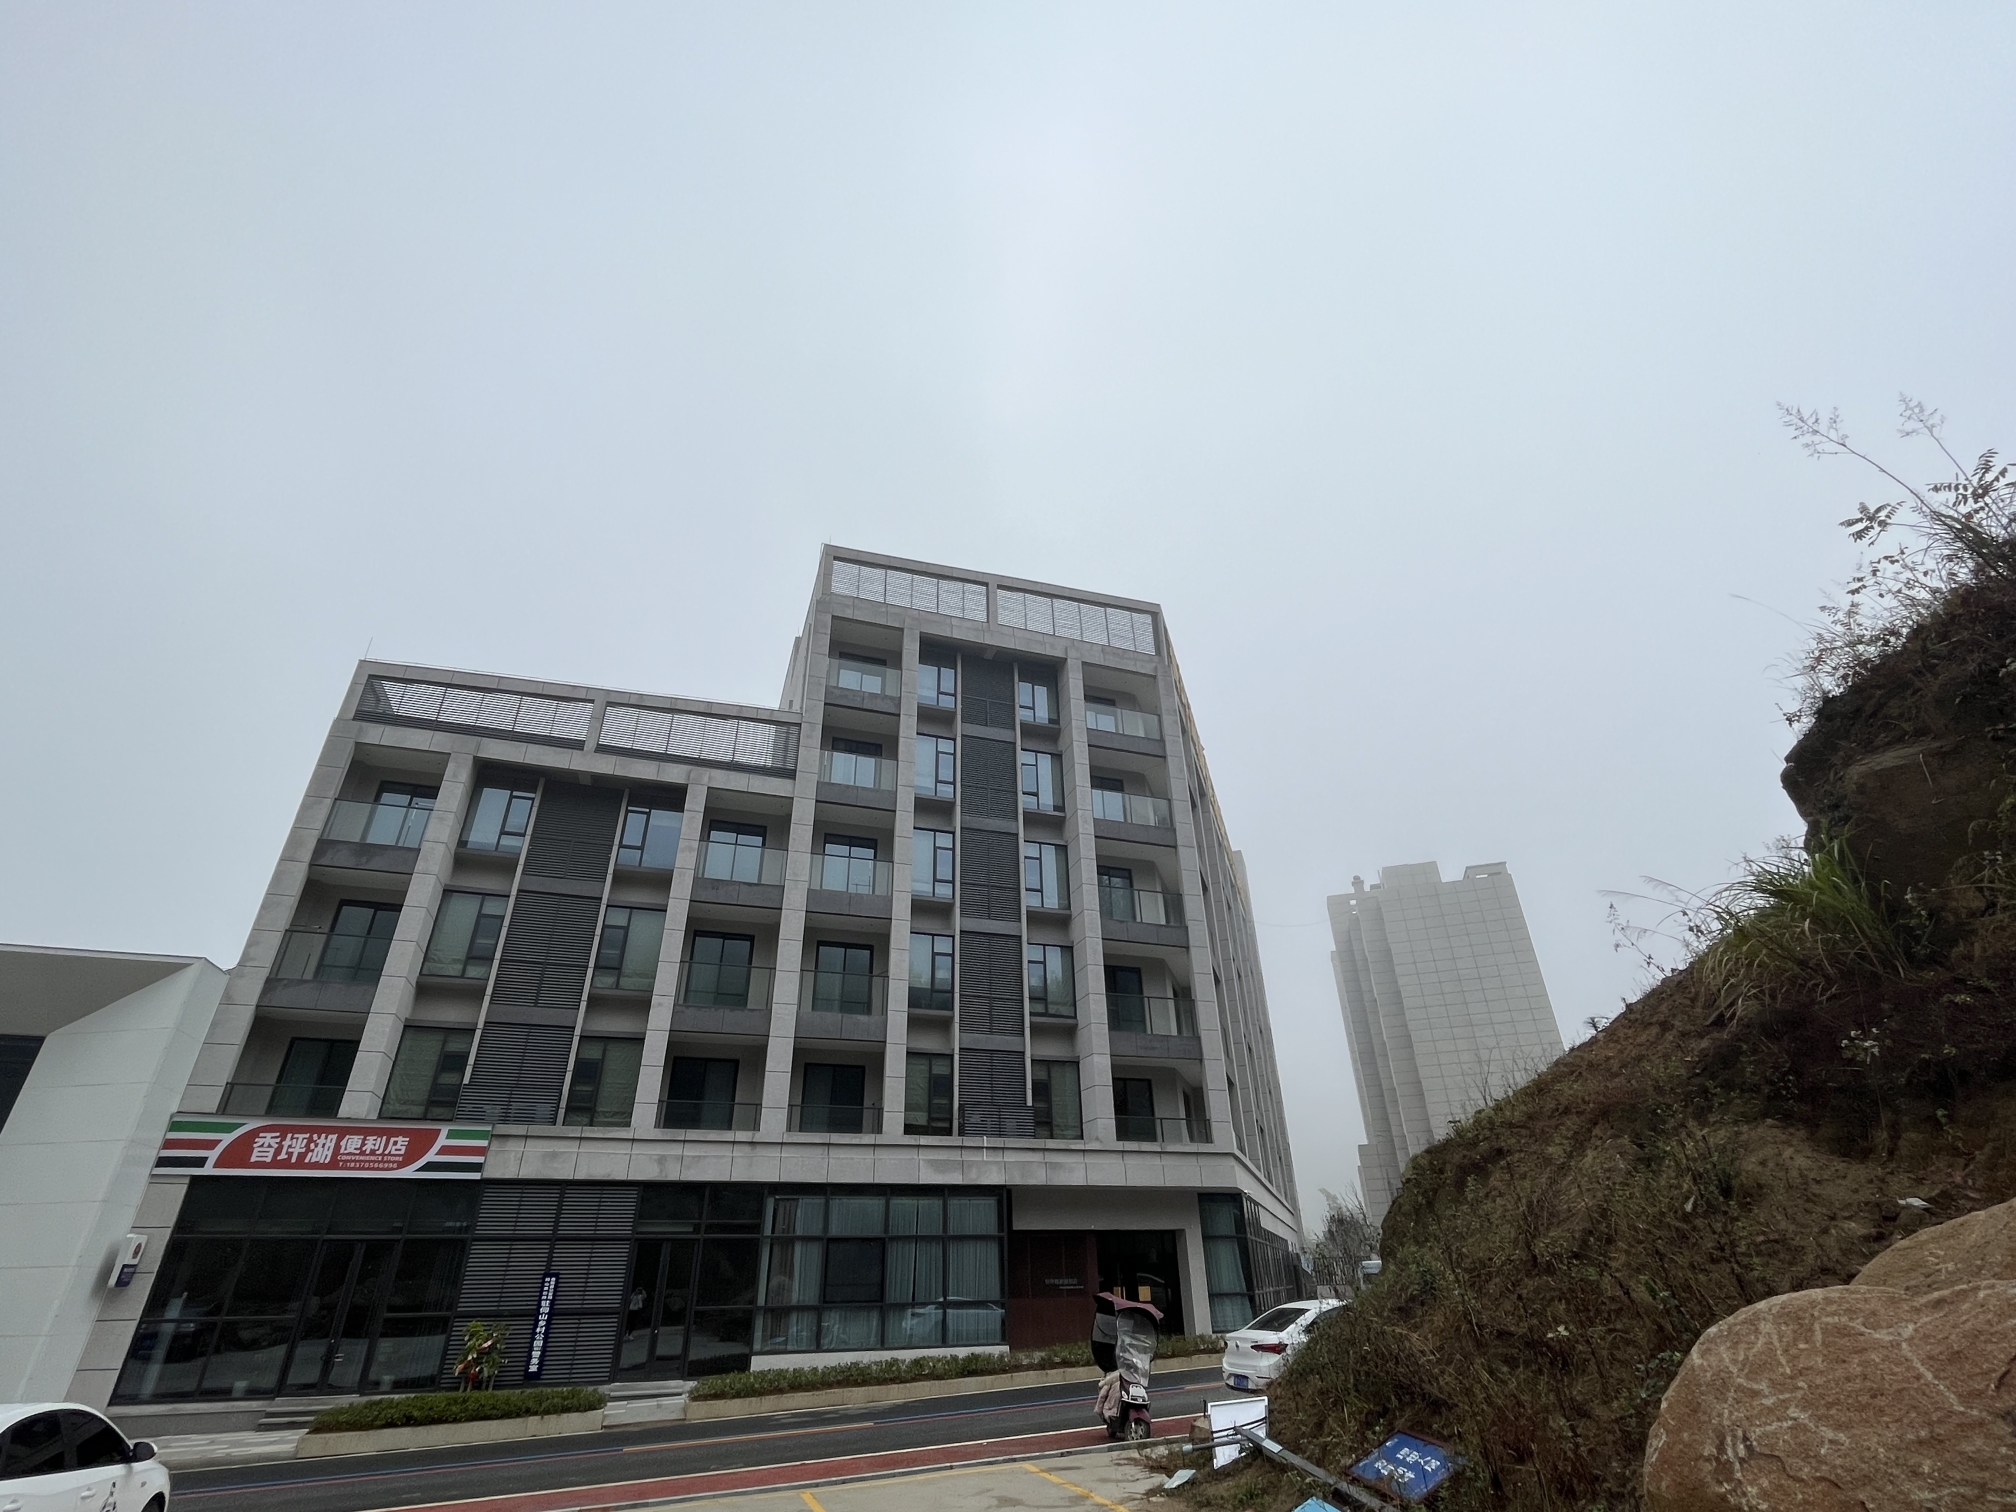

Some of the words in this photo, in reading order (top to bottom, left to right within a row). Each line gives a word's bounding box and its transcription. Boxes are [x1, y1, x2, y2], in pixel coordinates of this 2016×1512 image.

[249, 1132, 338, 1163] 香坪湖
[340, 1134, 410, 1154] 便利店
